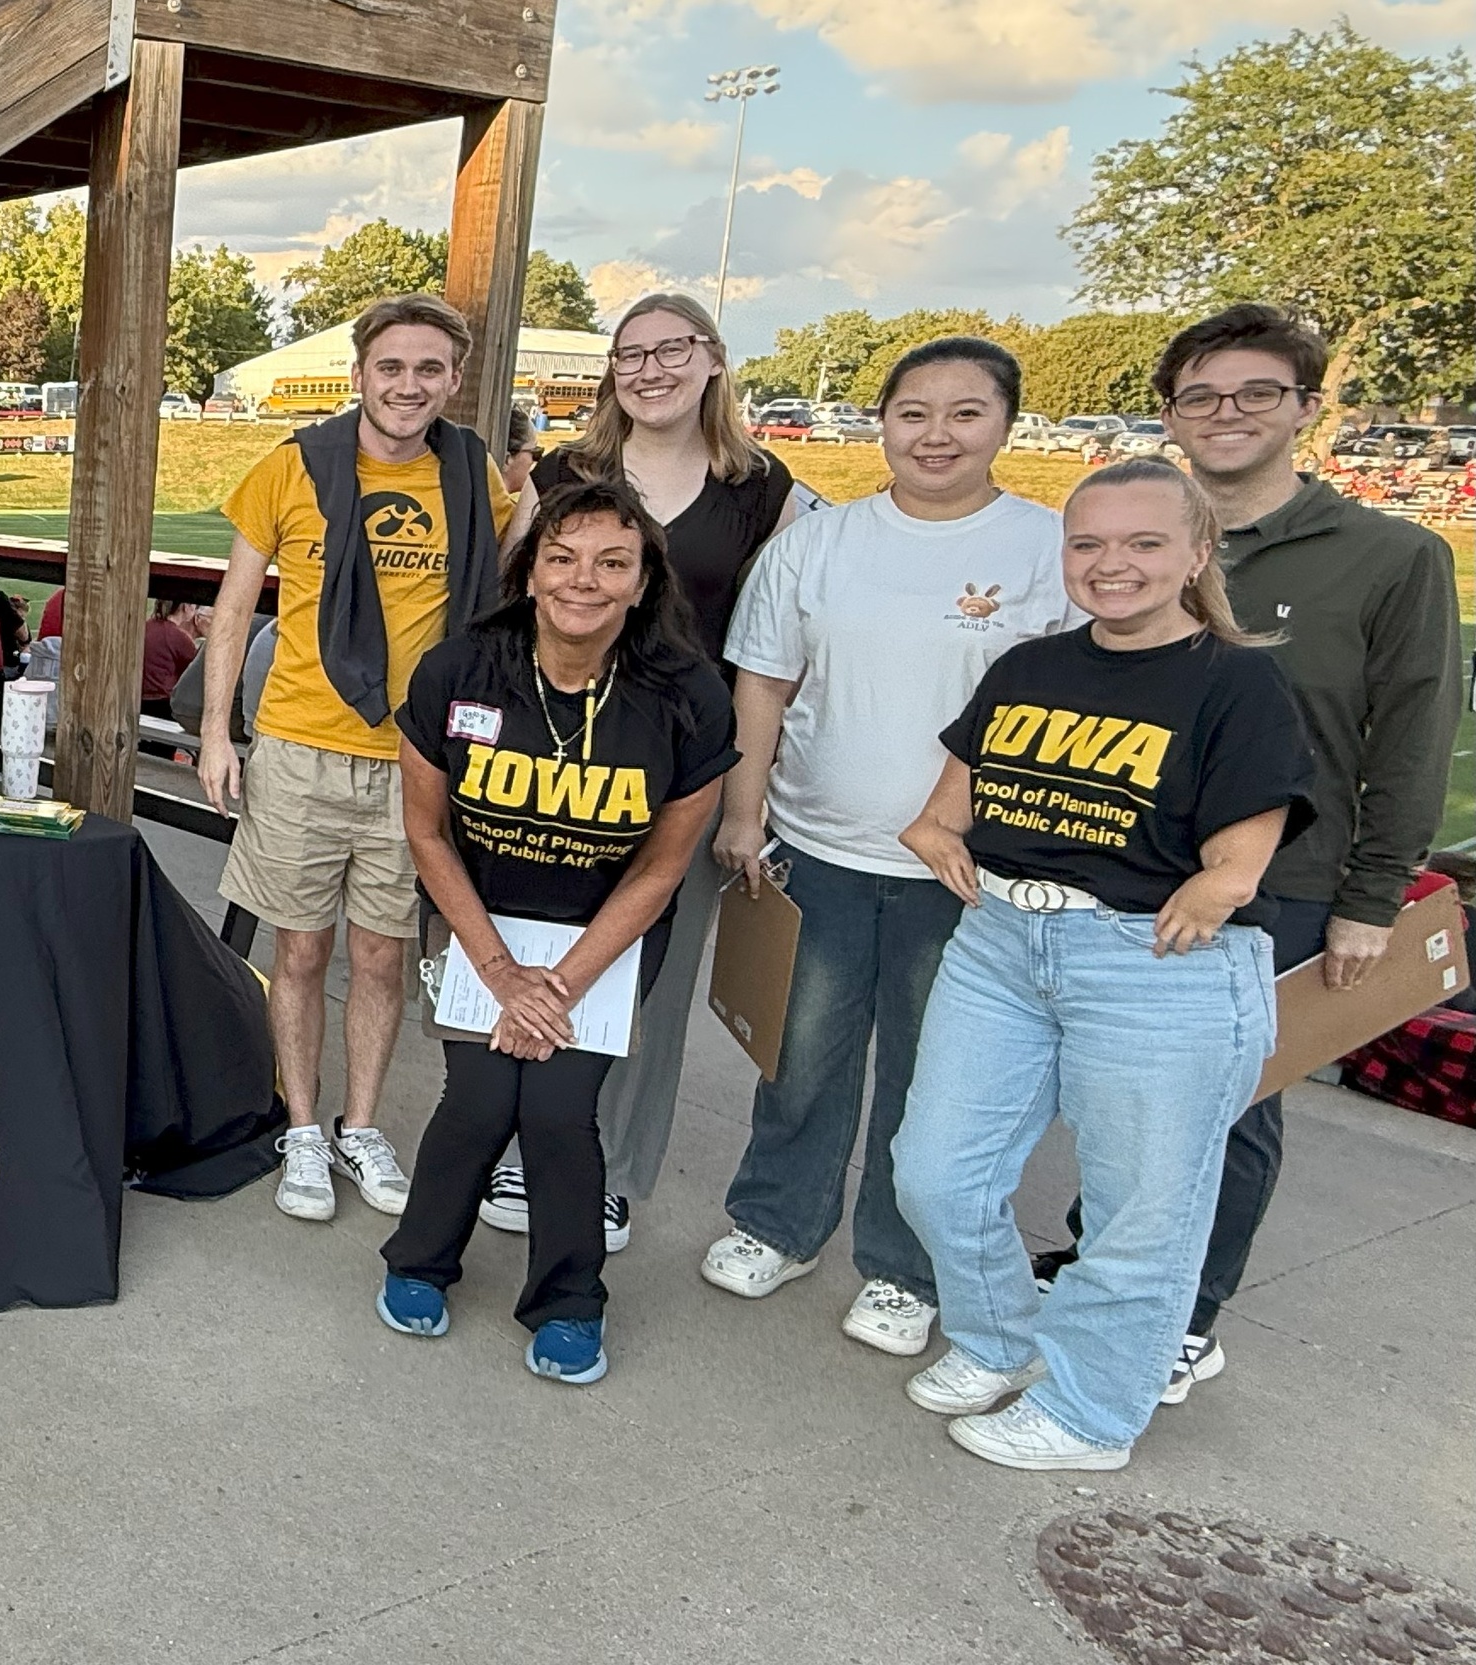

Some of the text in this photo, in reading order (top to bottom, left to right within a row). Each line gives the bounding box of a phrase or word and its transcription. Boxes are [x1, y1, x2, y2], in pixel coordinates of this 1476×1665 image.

[957, 621, 989, 632] ADLV
[458, 743, 652, 824] IOWA
[975, 777, 1138, 828] hool of Planning
[461, 815, 522, 841] School
[526, 833, 548, 848] of
[985, 803, 1051, 832] Public
[1053, 818, 1128, 848] Affairs
[466, 830, 494, 852] and
[498, 843, 557, 864] Public
